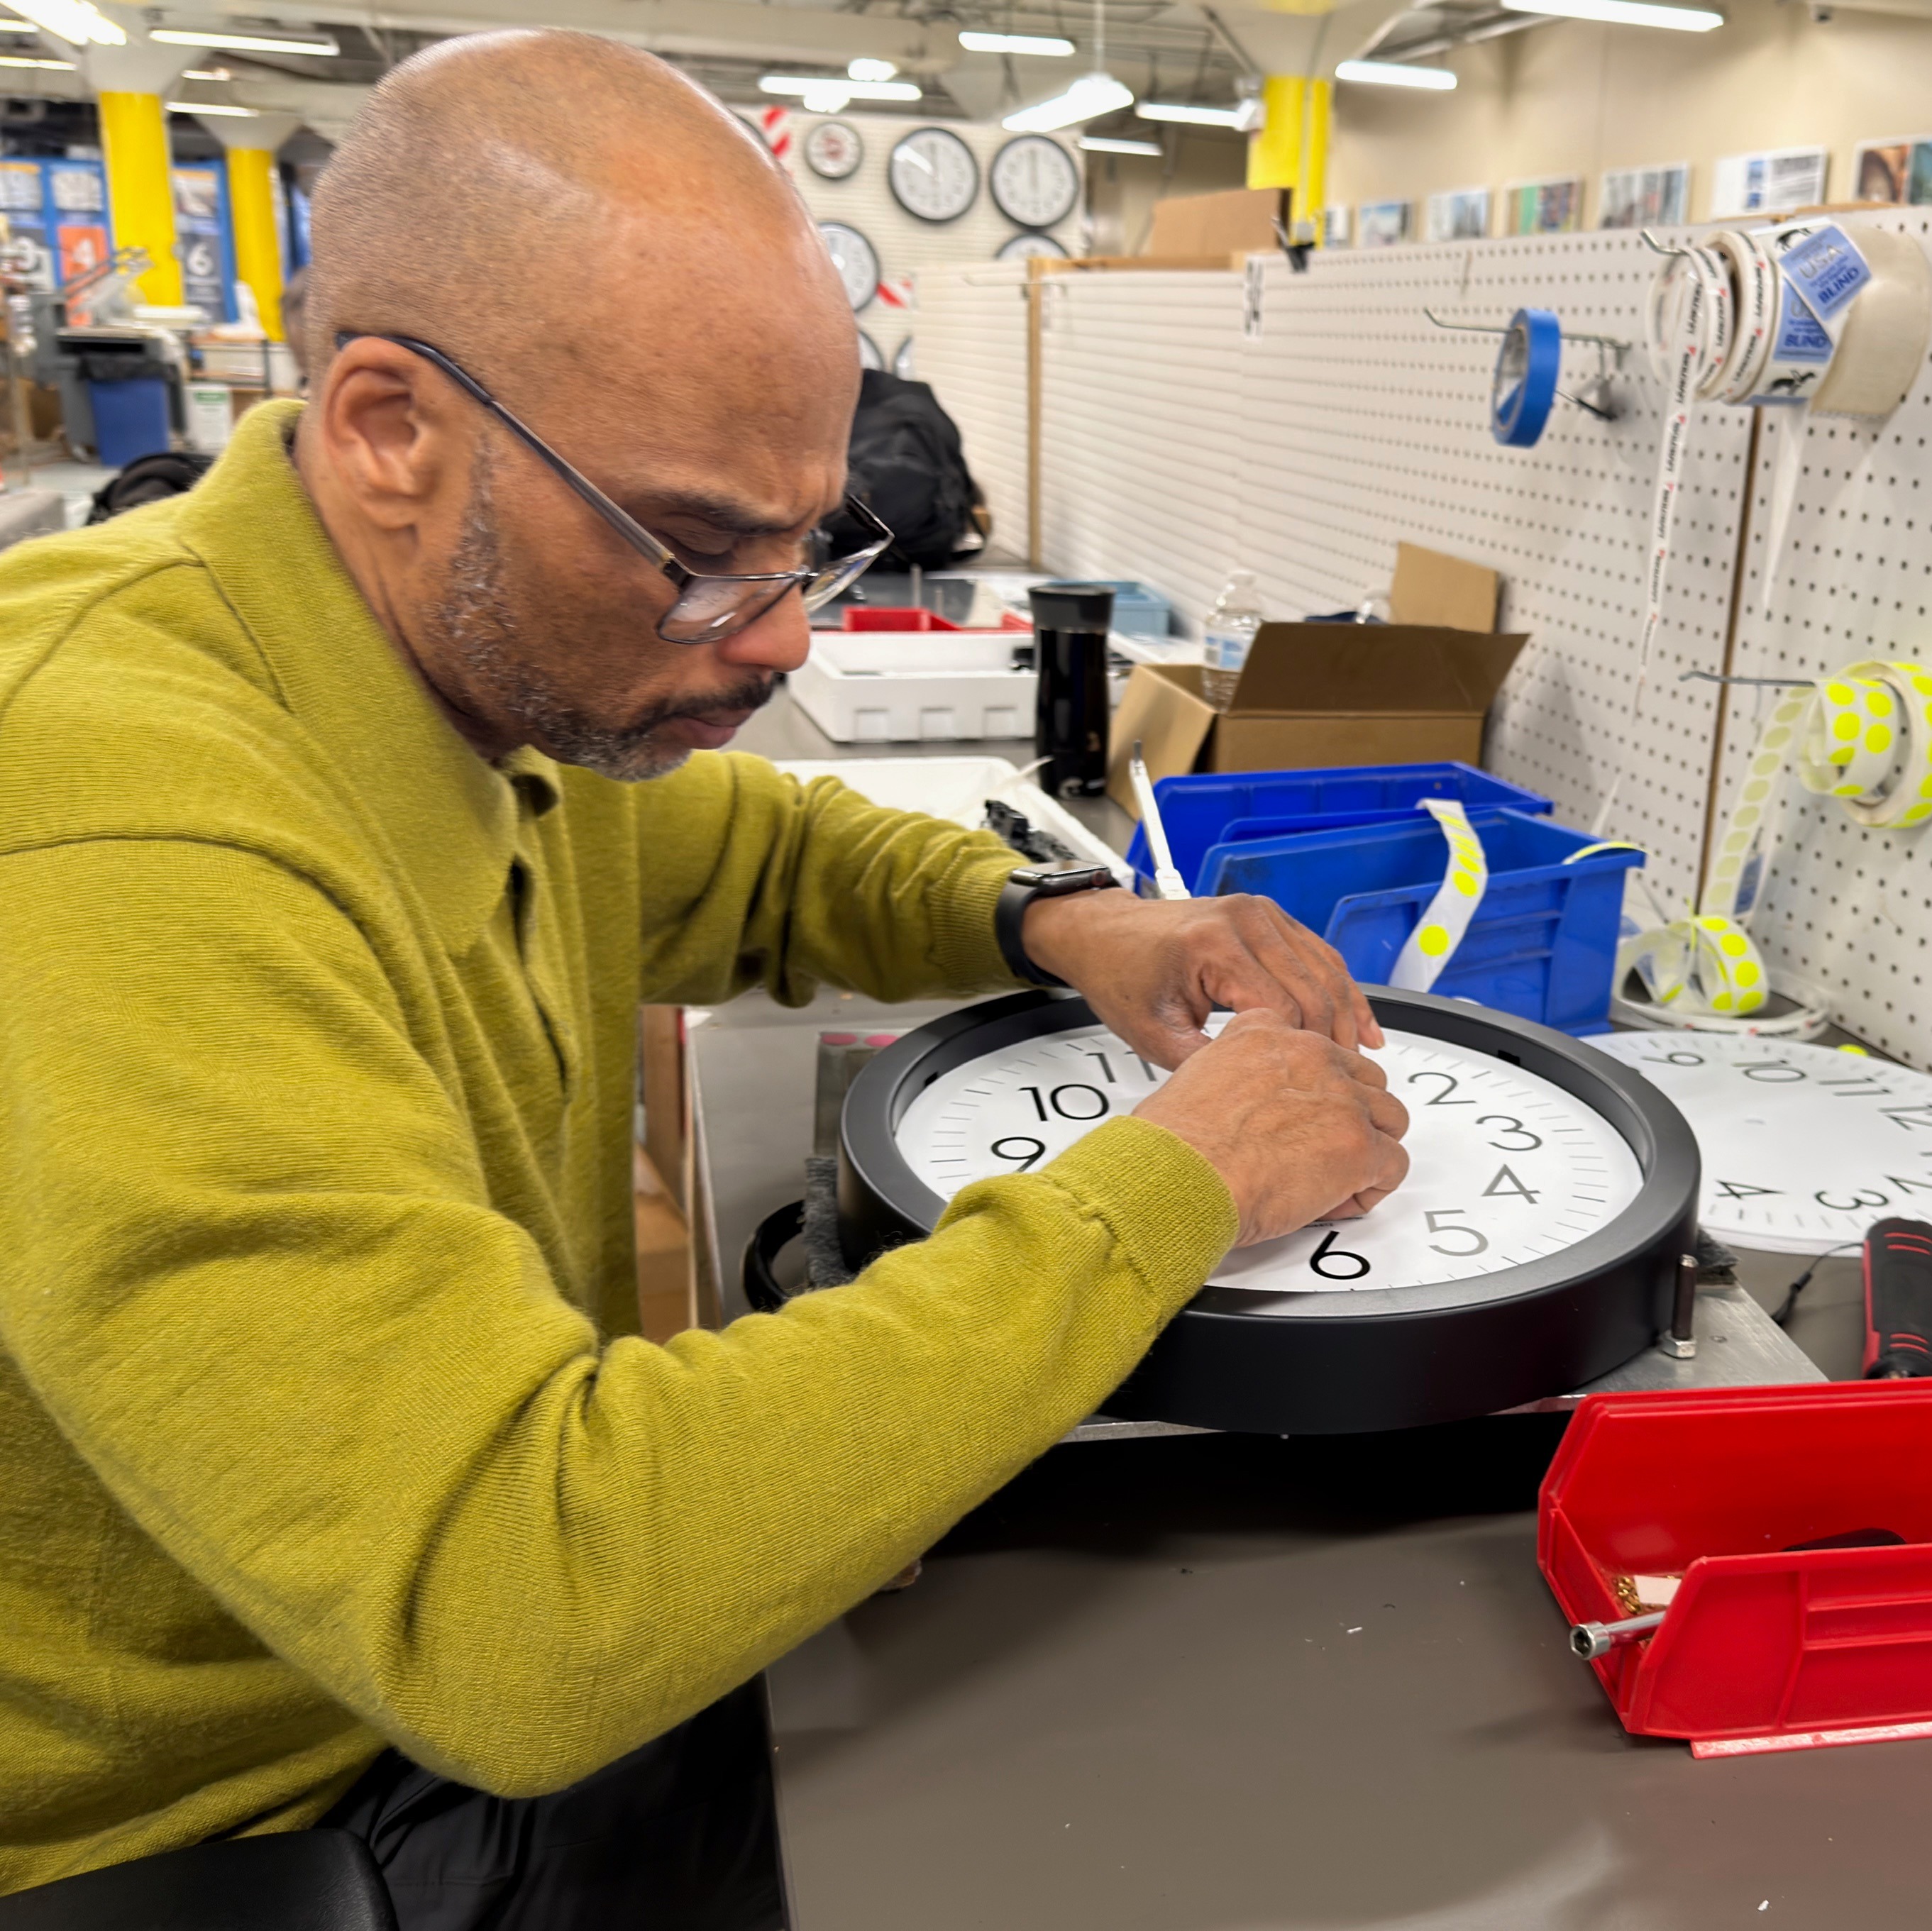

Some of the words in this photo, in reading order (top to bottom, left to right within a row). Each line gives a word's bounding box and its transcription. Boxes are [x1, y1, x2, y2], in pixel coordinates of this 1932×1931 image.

[187, 245, 213, 276] 6
[1799, 244, 1844, 279] USA
[1818, 267, 1859, 304] BLIND
[1017, 1083, 1110, 1122] 10
[1408, 1072, 1477, 1106] 2
[1475, 1115, 1542, 1151] 3
[991, 1136, 1046, 1173] 9
[1481, 1164, 1542, 1205] 4
[1714, 1179, 1786, 1200] 4
[1814, 1188, 1889, 1210] 3
[1423, 1209, 1489, 1257] 5
[1310, 1231, 1371, 1280] 6
